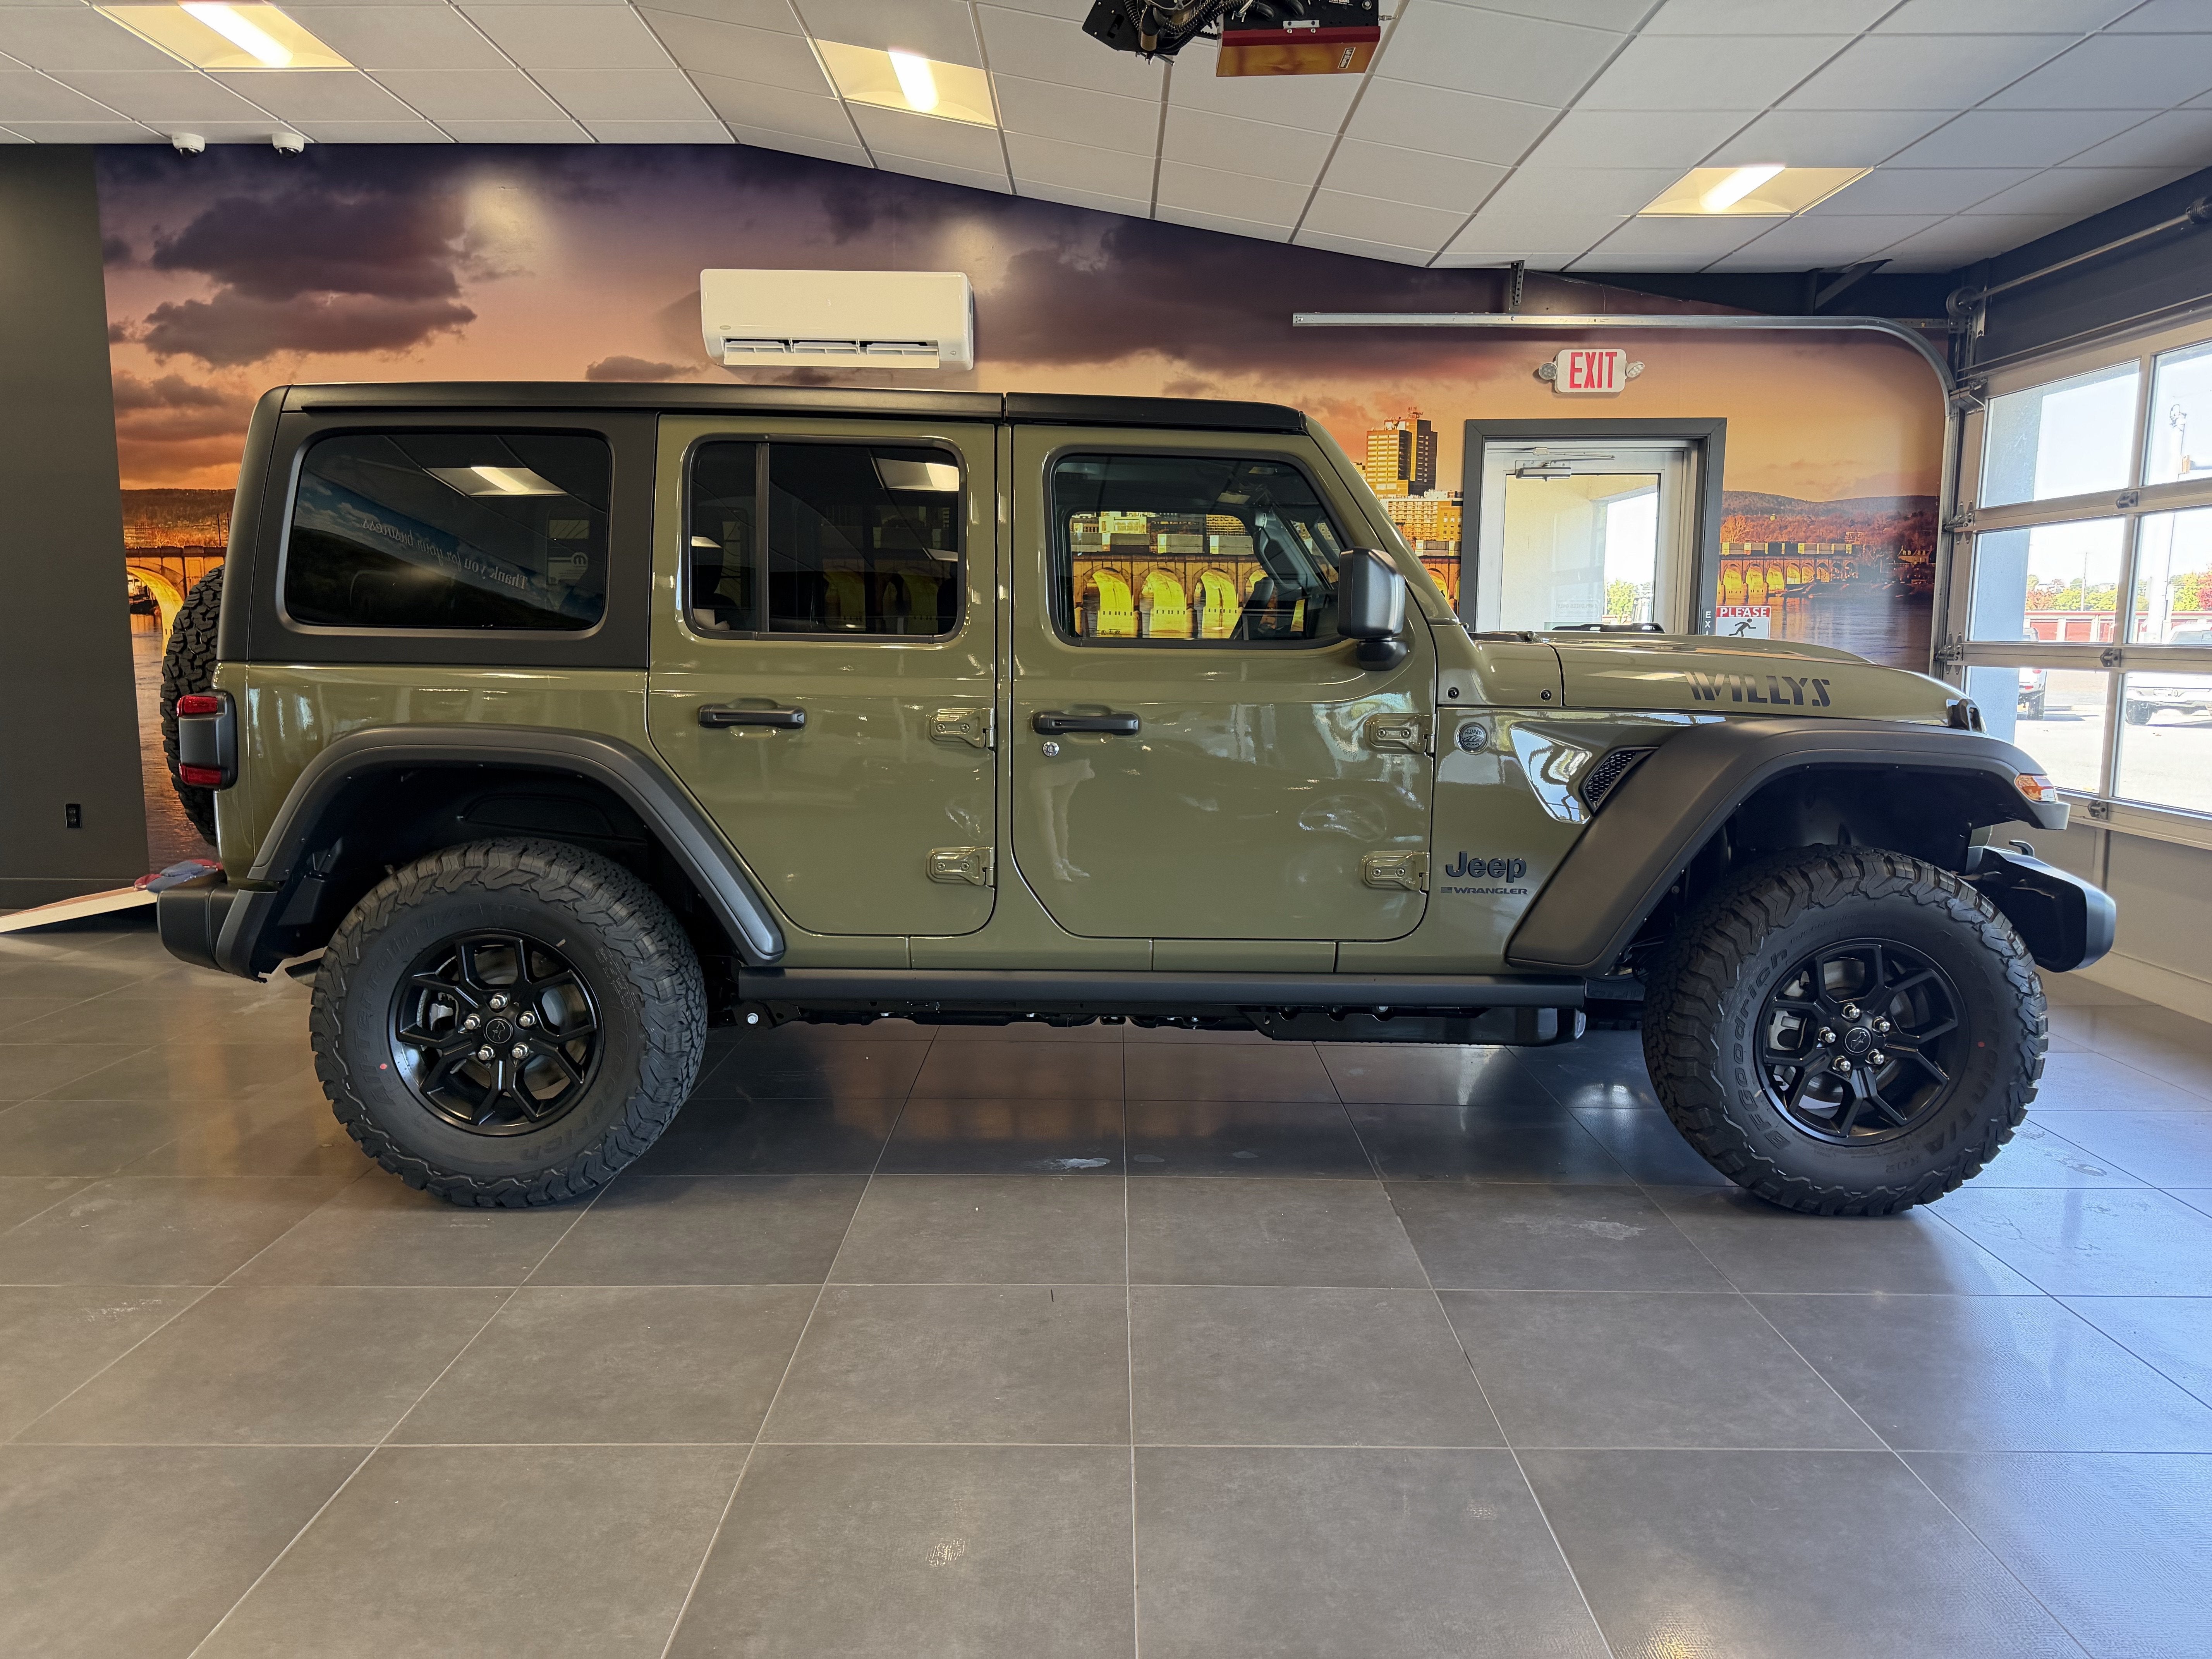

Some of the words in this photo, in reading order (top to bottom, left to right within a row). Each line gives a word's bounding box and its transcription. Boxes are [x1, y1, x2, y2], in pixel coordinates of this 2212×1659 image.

[1570, 352, 1617, 388] EXIT
[1720, 607, 1767, 617] PLEASE
[1683, 671, 1830, 707] WILLYS
[1445, 851, 1527, 883] Jeep
[1453, 887, 1528, 895] WRANGLER
[1733, 948, 1791, 1149] BFGoodrich
